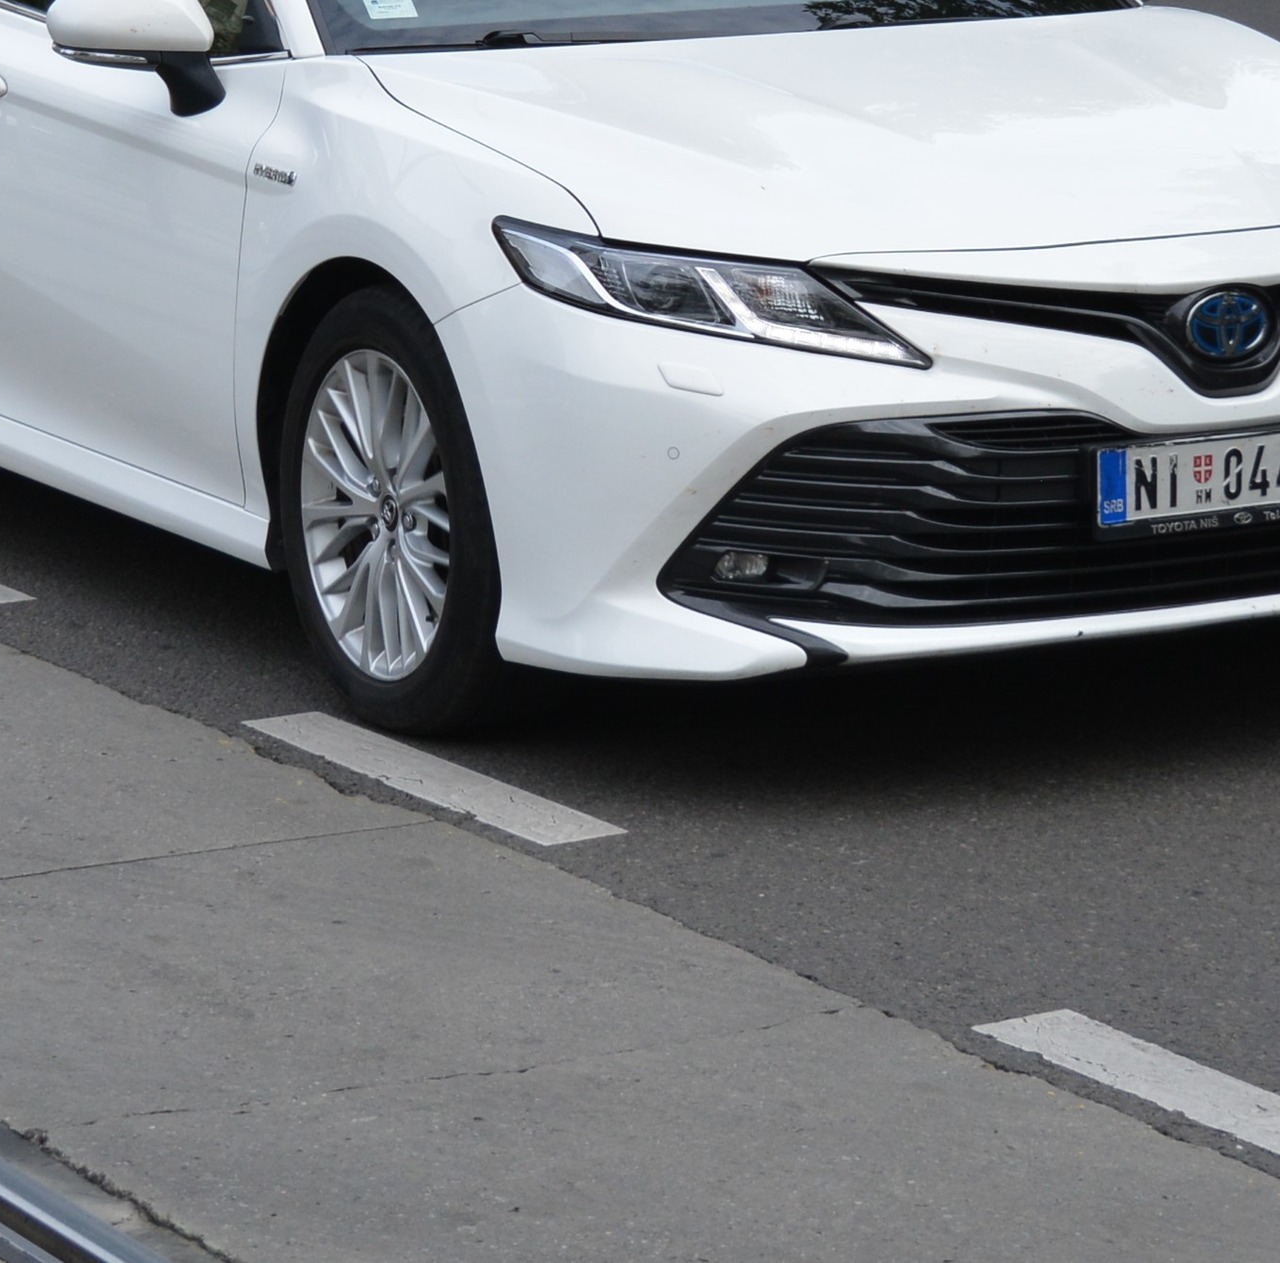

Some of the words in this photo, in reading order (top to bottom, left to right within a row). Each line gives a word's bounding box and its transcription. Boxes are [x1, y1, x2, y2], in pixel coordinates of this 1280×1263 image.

[1134, 454, 1178, 511] NI
[1103, 498, 1125, 515] SRB
[1151, 519, 1198, 535] TOYOTA
[1199, 513, 1219, 529] NIŠ
